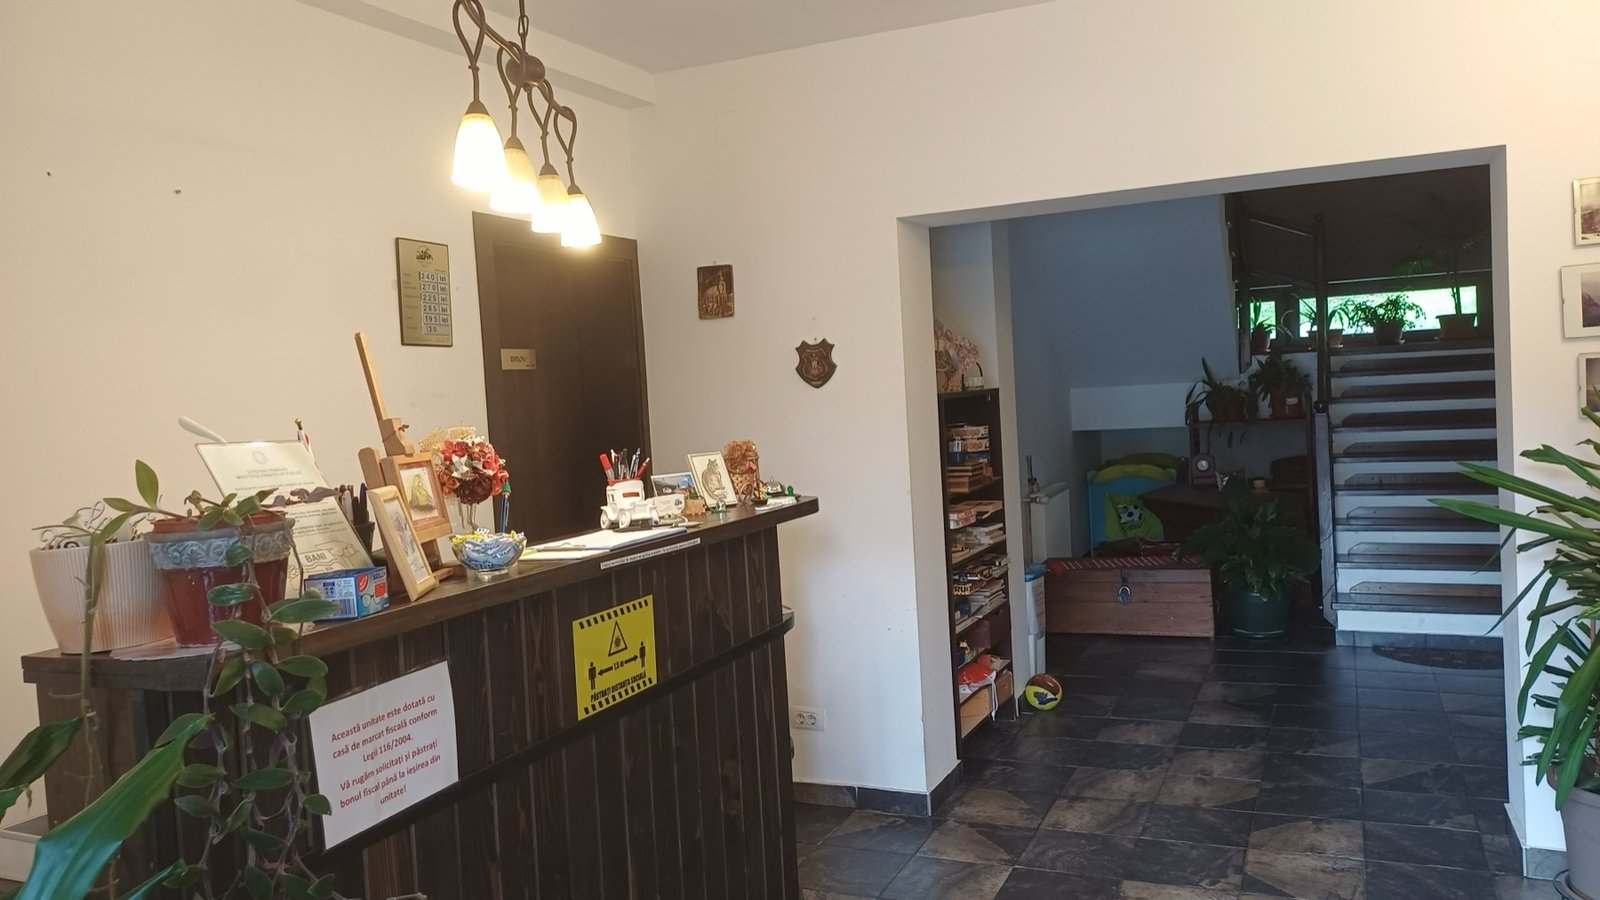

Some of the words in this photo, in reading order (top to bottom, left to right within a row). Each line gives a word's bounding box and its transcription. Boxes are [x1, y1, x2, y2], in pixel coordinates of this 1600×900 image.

[304, 552, 328, 563] BANI
[331, 722, 361, 742] Această
[361, 714, 386, 730] unitate
[386, 707, 402, 719] este
[402, 698, 426, 713] dotată
[427, 694, 436, 703] cu
[332, 744, 351, 759] casă
[351, 738, 361, 751] de
[361, 731, 385, 746] marcat
[385, 719, 408, 737] fiscală
[408, 708, 438, 726] conform
[362, 749, 379, 763] Legii
[379, 733, 413, 754] 116/2004.
[340, 780, 351, 792] Vă
[351, 770, 375, 787] rugăm
[340, 790, 362, 809] bonul
[362, 783, 381, 798] fiscal
[381, 775, 398, 789] până
[398, 770, 406, 779] la
[429, 753, 441, 765] din
[380, 785, 407, 805] unitate!
